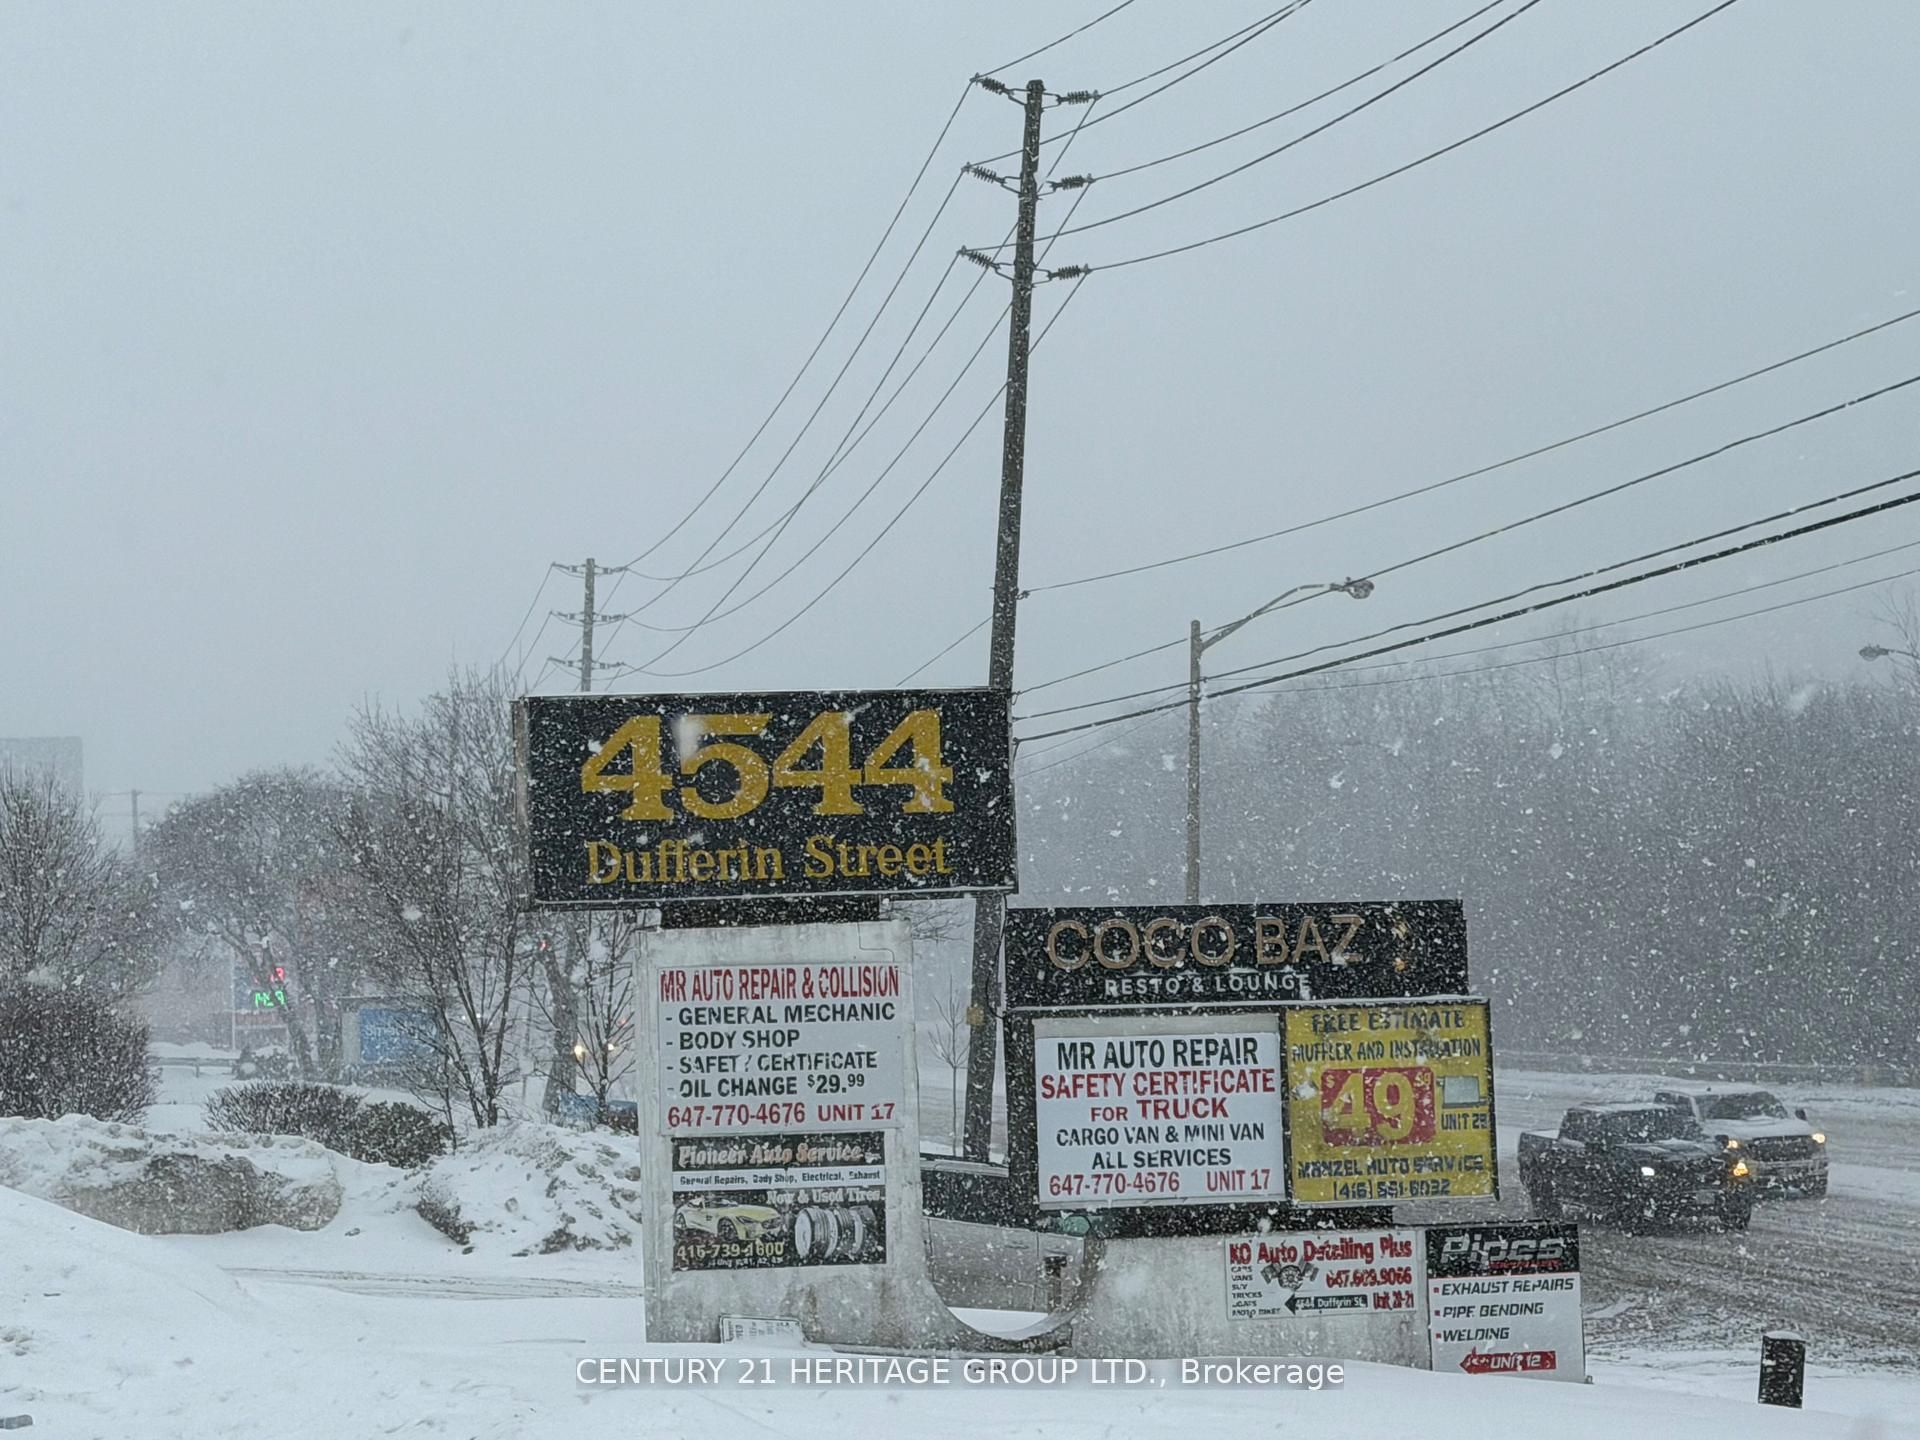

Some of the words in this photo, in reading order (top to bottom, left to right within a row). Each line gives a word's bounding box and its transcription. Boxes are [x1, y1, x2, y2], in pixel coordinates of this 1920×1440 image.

[581, 709, 955, 822] 4544
[586, 836, 786, 885] Dufferin
[804, 833, 953, 879] Street
[1046, 915, 1235, 970] COCO
[1255, 913, 1363, 966] BAZ
[660, 970, 687, 1003] MR
[692, 969, 734, 1002] AUTO
[740, 967, 797, 1000] REPAIR
[802, 967, 814, 998] &
[819, 965, 899, 998] COLLISION
[1105, 976, 1182, 997] RESTO
[1192, 976, 1204, 993] &
[1215, 973, 1311, 994] LOUNGE
[678, 1006, 778, 1026] GENERAL
[784, 1002, 896, 1024] MECHANIC
[1311, 1013, 1362, 1035] FREE
[1368, 1010, 1465, 1031] ESTIMATE
[680, 1031, 737, 1050] BODY
[742, 1029, 800, 1049] SHOP
[1292, 1042, 1352, 1063] MUFFLER
[1357, 1040, 1385, 1060] AND
[757, 1051, 878, 1072] CERTIFICATE
[1057, 1041, 1096, 1070] MR
[1103, 1039, 1165, 1069] AUTO
[1172, 1037, 1259, 1067] REPAIR
[680, 1078, 712, 1098] OIL
[718, 1076, 798, 1097] CHANGE
[807, 1074, 865, 1094] $29.99
[1041, 1072, 1127, 1100] SAFETY
[1133, 1068, 1276, 1097] CERTIFICATE
[668, 1103, 806, 1127] 647-770-4676
[818, 1104, 866, 1122] UNIT
[871, 1103, 896, 1121] 17
[1091, 1106, 1129, 1122] FOR
[1136, 1097, 1230, 1121] TRUCK
[1326, 1071, 1417, 1141] 49
[1441, 1113, 1470, 1131] UNIT
[1056, 1127, 1119, 1147] CARGO
[1124, 1125, 1160, 1144] VAN
[1165, 1125, 1179, 1143] &
[1184, 1123, 1225, 1143] MINI
[1230, 1122, 1265, 1141] VAN
[750, 1143, 793, 1165] Auto
[1092, 1151, 1128, 1171] ALL
[1133, 1148, 1232, 1168] SERVICES
[1049, 1171, 1181, 1197] 647-770-4676
[1206, 1170, 1246, 1192] UNIT
[1251, 1169, 1271, 1190] 17
[1257, 1240, 1298, 1264] Auto
[1442, 1281, 1510, 1296] EXHAUST
[1512, 1278, 1575, 1293] REPAIRS
[1443, 1305, 1476, 1318] PIPE
[1480, 1302, 1545, 1317] BENDING
[1443, 1327, 1510, 1342] WELDING
